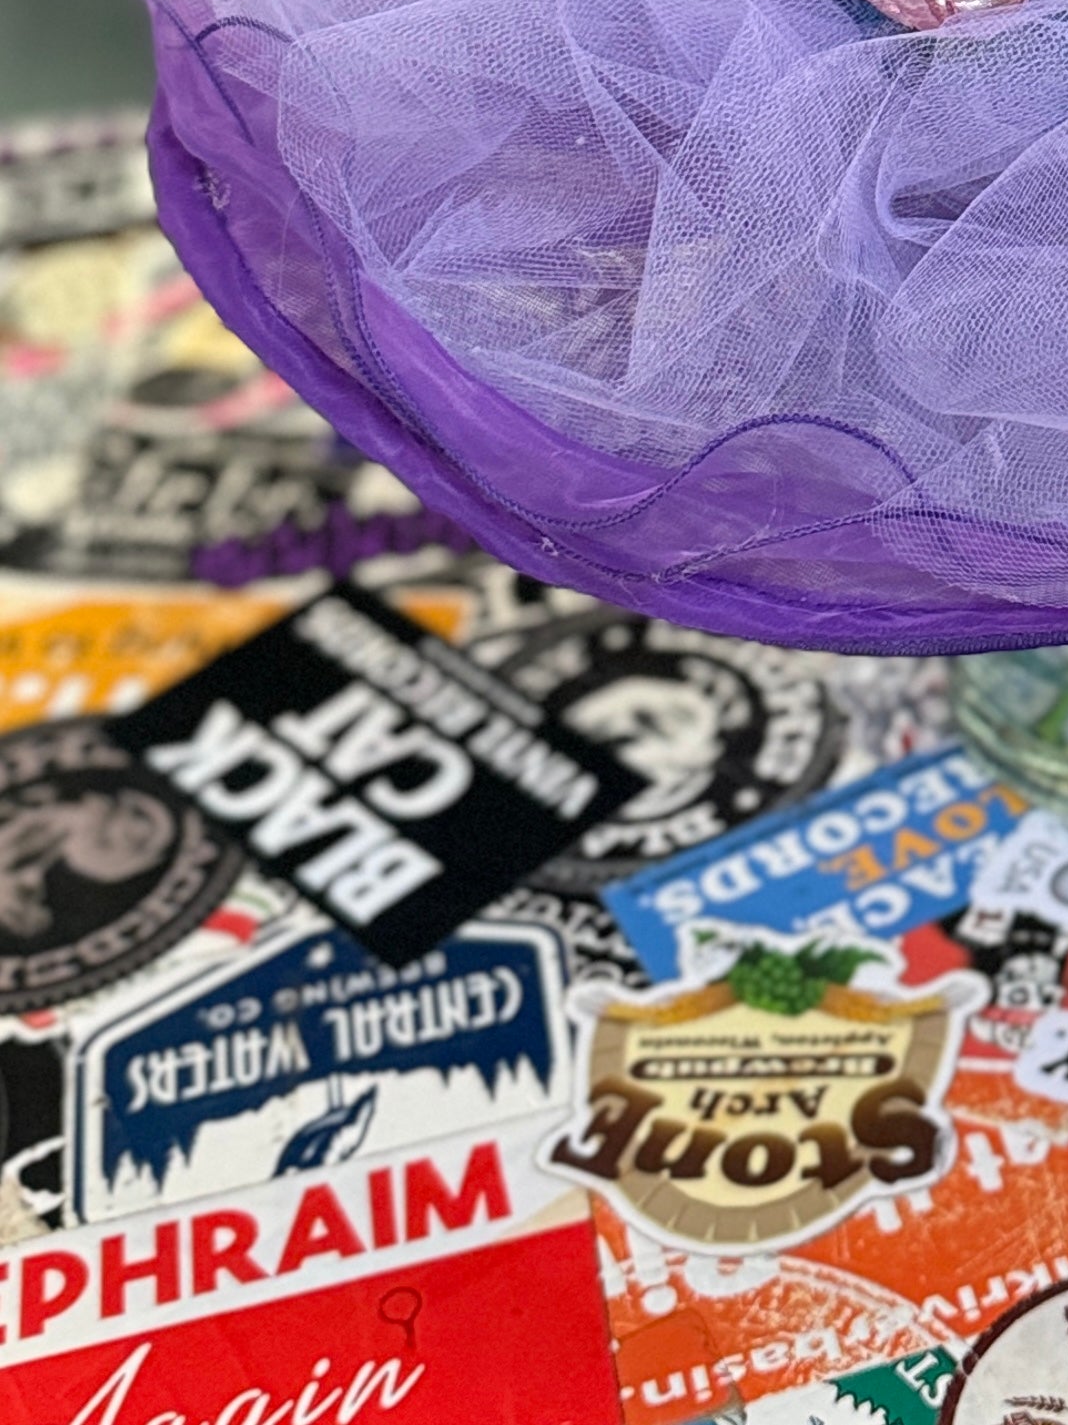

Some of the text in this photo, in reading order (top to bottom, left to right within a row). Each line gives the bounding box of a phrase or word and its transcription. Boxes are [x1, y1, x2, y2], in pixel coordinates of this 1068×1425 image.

[147, 698, 442, 925] BLACK
[271, 682, 473, 821] CAT
[467, 712, 599, 821] VINYL
[126, 965, 523, 1113] CENTRAL WATERS
[637, 1034, 761, 1050] Wisconsin
[644, 1056, 879, 1076] Brewpub
[690, 1085, 828, 1121] Arch
[0, 1140, 512, 1346] PHRAIM
